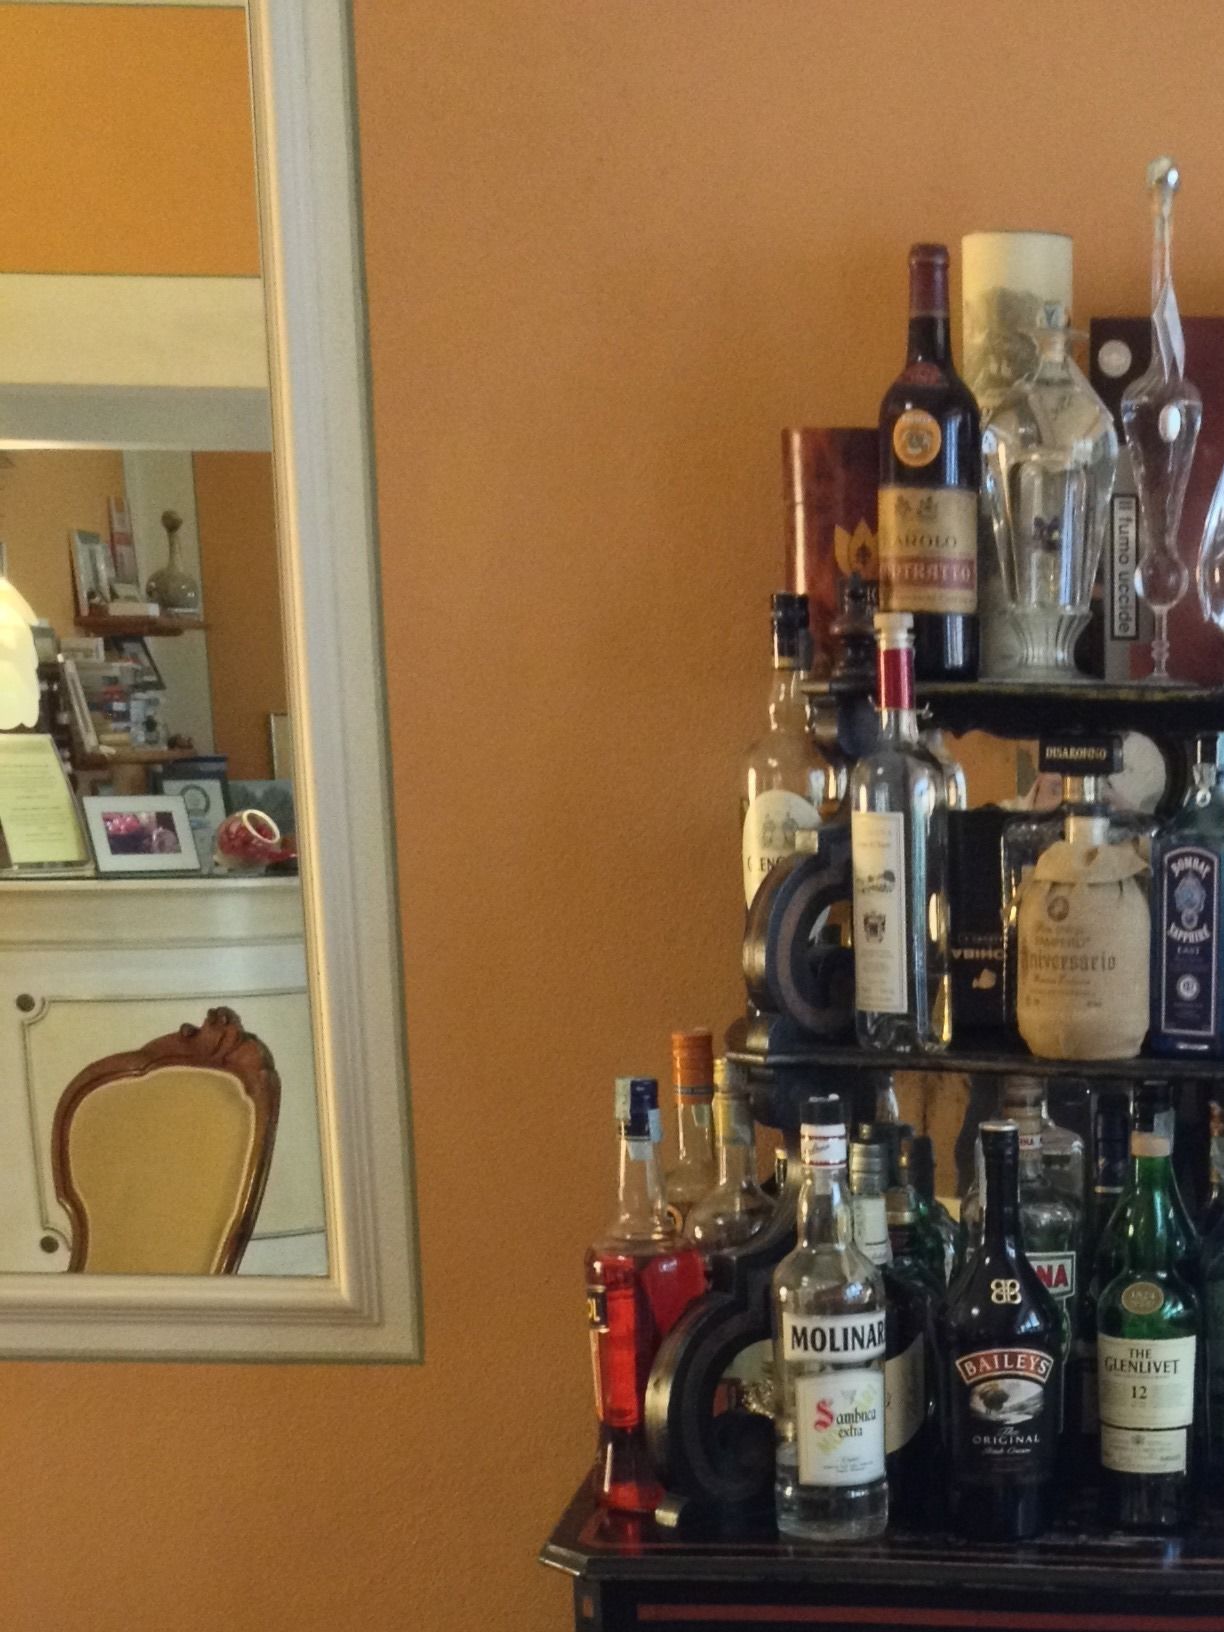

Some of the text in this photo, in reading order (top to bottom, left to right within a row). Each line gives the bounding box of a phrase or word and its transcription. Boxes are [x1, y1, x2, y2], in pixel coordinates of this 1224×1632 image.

[1117, 516, 1132, 566] fumo
[1117, 571, 1133, 634] uccide
[1170, 855, 1212, 879] BOMBAY
[1128, 1347, 1153, 1360] THE
[963, 1353, 1050, 1378] BAILEYS
[1103, 1357, 1181, 1375] GLENLIVET
[1130, 1384, 1148, 1400] 12
[813, 1397, 877, 1433] Sambuca
[837, 1425, 864, 1439] extra
[971, 1433, 1041, 1445] ORIGINAL
